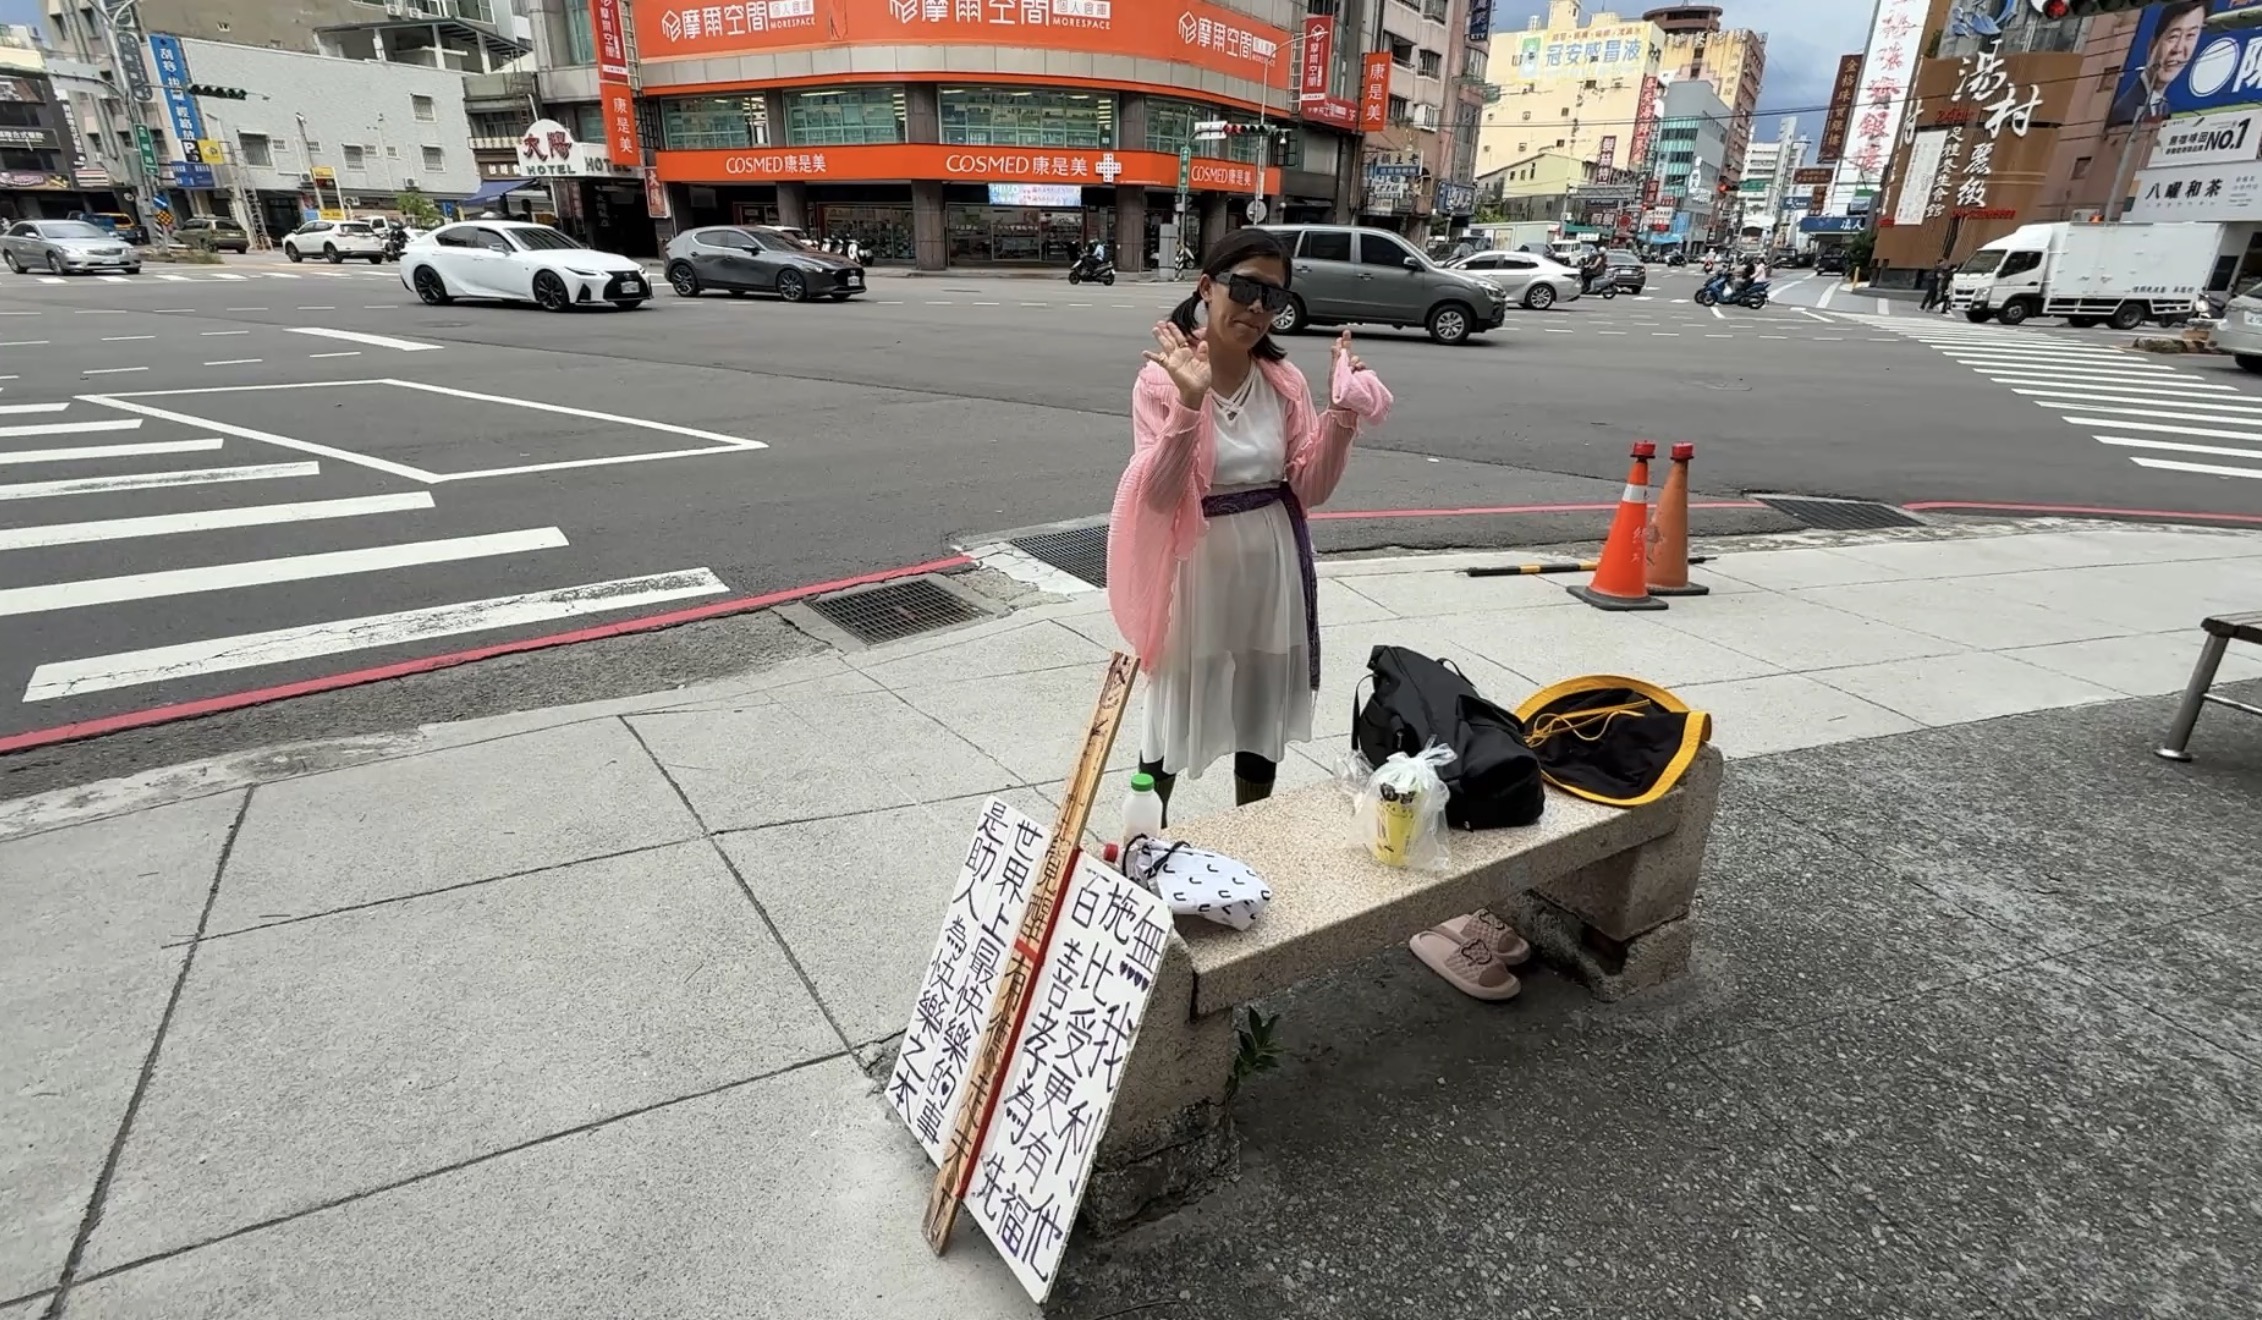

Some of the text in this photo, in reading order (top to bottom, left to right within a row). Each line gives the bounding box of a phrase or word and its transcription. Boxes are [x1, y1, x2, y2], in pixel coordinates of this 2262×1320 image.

[681, 2, 769, 39] 摩爾空間
[770, 17, 815, 29] MORESPACE
[922, 0, 1049, 25] 摩爾空間
[1052, 16, 1111, 30] MORESPACE
[1197, 17, 1253, 60] 摩爾空間
[1546, 39, 1641, 66] 冠安感冒液
[1366, 63, 1386, 121] 康是美
[613, 97, 632, 153] 康是美
[2204, 117, 2251, 151] NO.1
[183, 142, 195, 154] P
[526, 165, 576, 175] HOTEL
[726, 154, 826, 173] COSMED 康是美
[946, 154, 1087, 176] COSMED 康是美
[1191, 165, 1228, 184] COSMED
[1228, 168, 1251, 186] 康是美
[2145, 178, 2223, 200] 八曜和茶
[890, 801, 1008, 1125] 是助人為快樂之本
[917, 819, 1043, 1145] 世界上最快樂的事
[997, 881, 1139, 1257] 施比受更有福
[1022, 904, 1165, 1281] 無我利他
